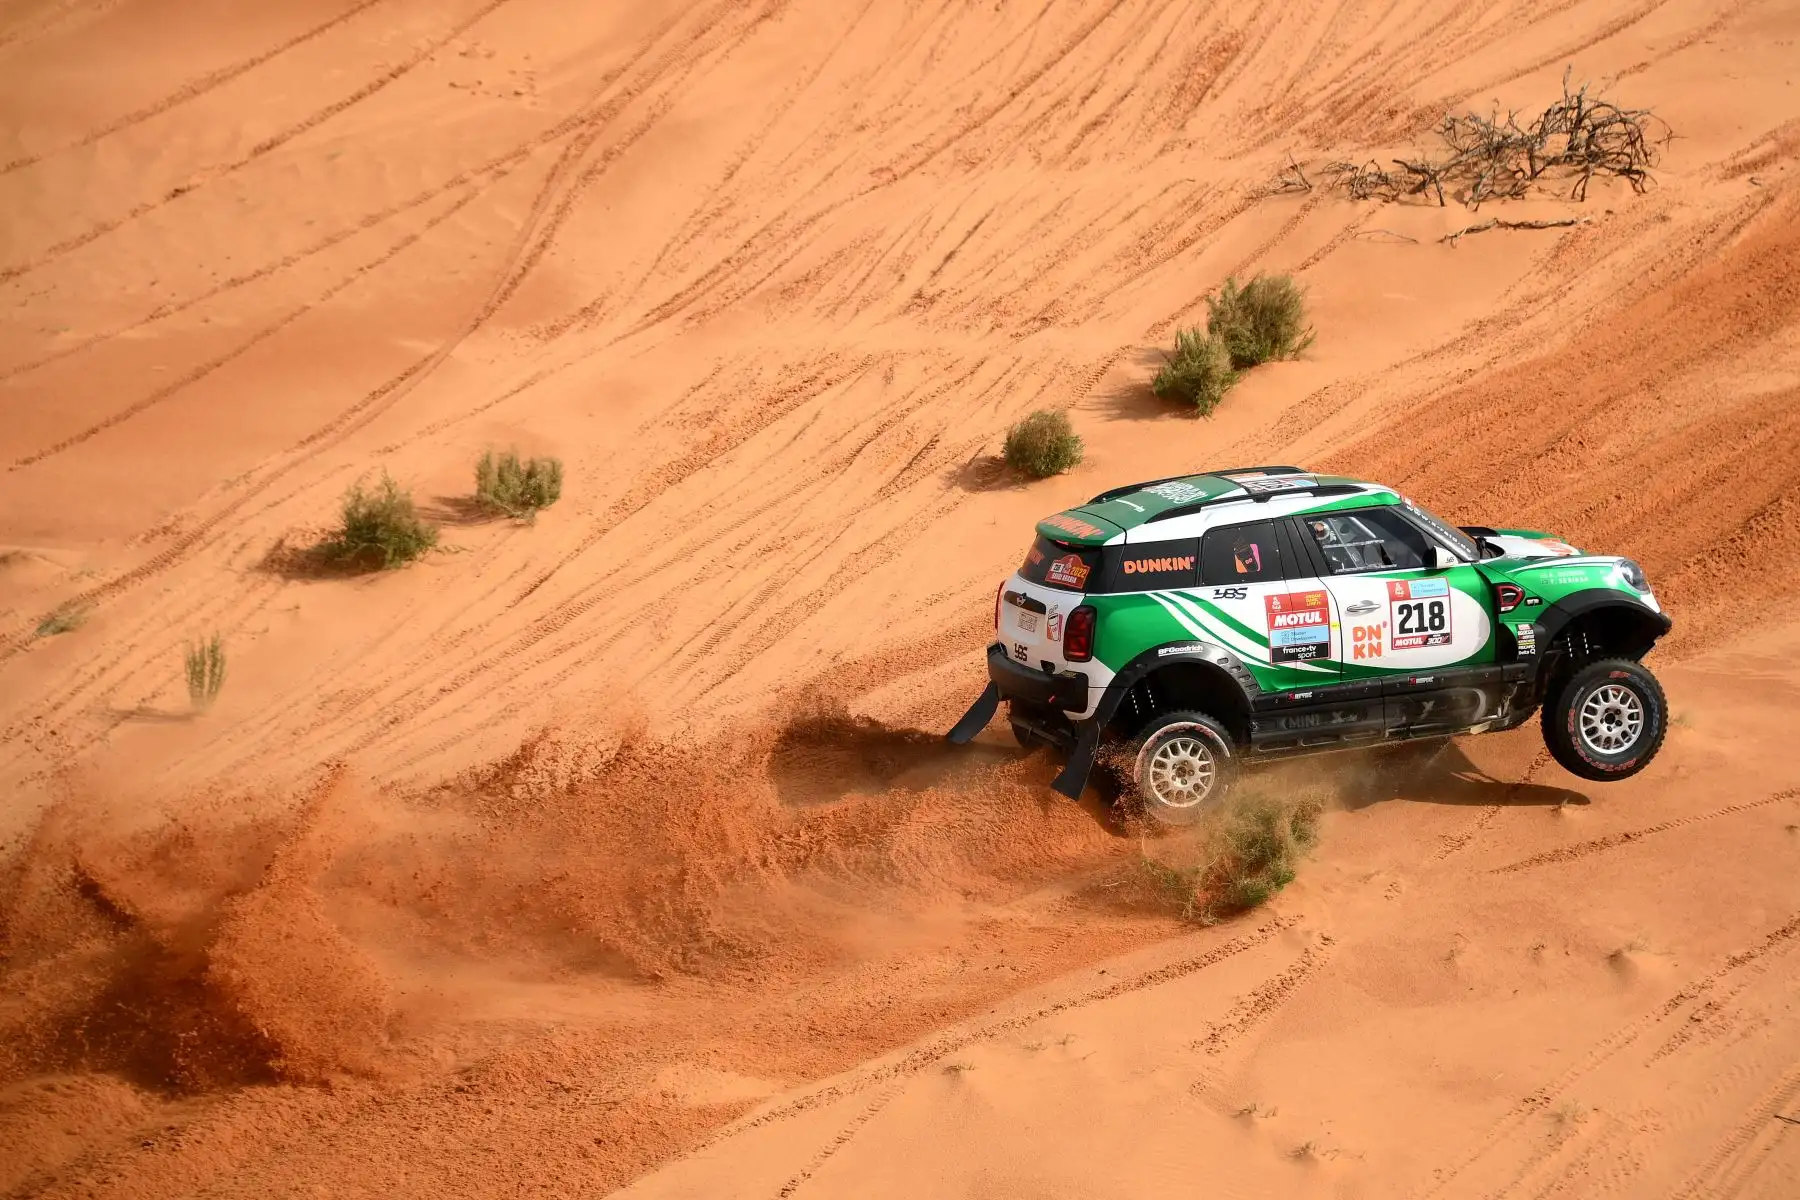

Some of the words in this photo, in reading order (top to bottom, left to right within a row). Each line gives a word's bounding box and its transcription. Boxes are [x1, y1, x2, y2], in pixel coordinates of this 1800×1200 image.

[1123, 555, 1195, 574] DUNKIN'
[1069, 566, 1087, 578] 2022
[1273, 611, 1322, 627] MOTUL
[1398, 601, 1446, 634] 218
[1394, 637, 1423, 647] MOTUL
[1158, 645, 1204, 656] BFGoodrich
[1297, 651, 1317, 661] sport
[1353, 641, 1382, 660] KN
